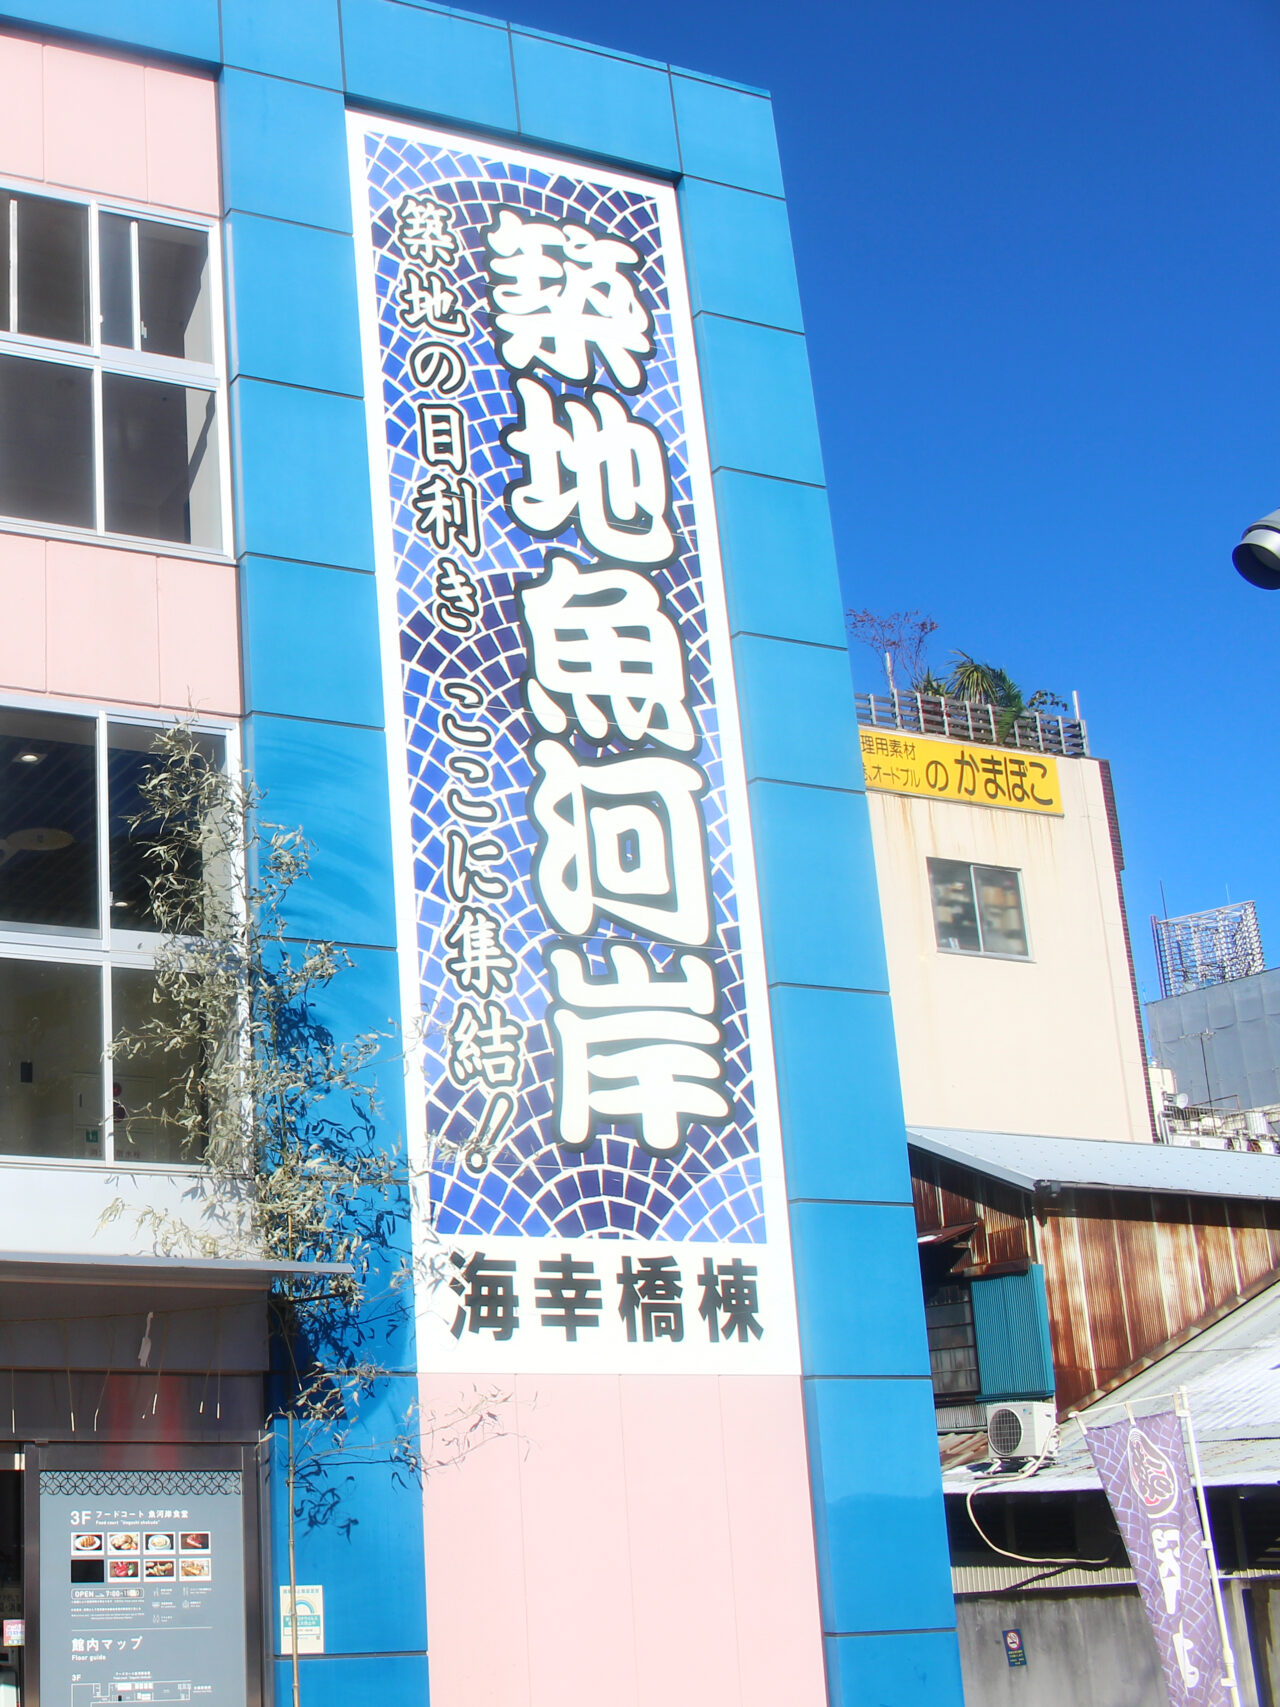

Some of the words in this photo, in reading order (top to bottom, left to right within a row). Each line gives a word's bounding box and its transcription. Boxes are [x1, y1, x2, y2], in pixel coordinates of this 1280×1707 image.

[482, 204, 734, 1157] 築地魚河岸
[925, 750, 1053, 806] のかまぼこ
[449, 1251, 764, 1343] 海幸橋棟
[70, 1510, 92, 1525] 3F
[95, 1510, 144, 1518] フードコート
[148, 1510, 189, 1519] 魚河岸食堂
[74, 1590, 94, 1598] OPEN
[71, 1635, 143, 1652] 館内マップ
[89, 1654, 106, 1662] guide
